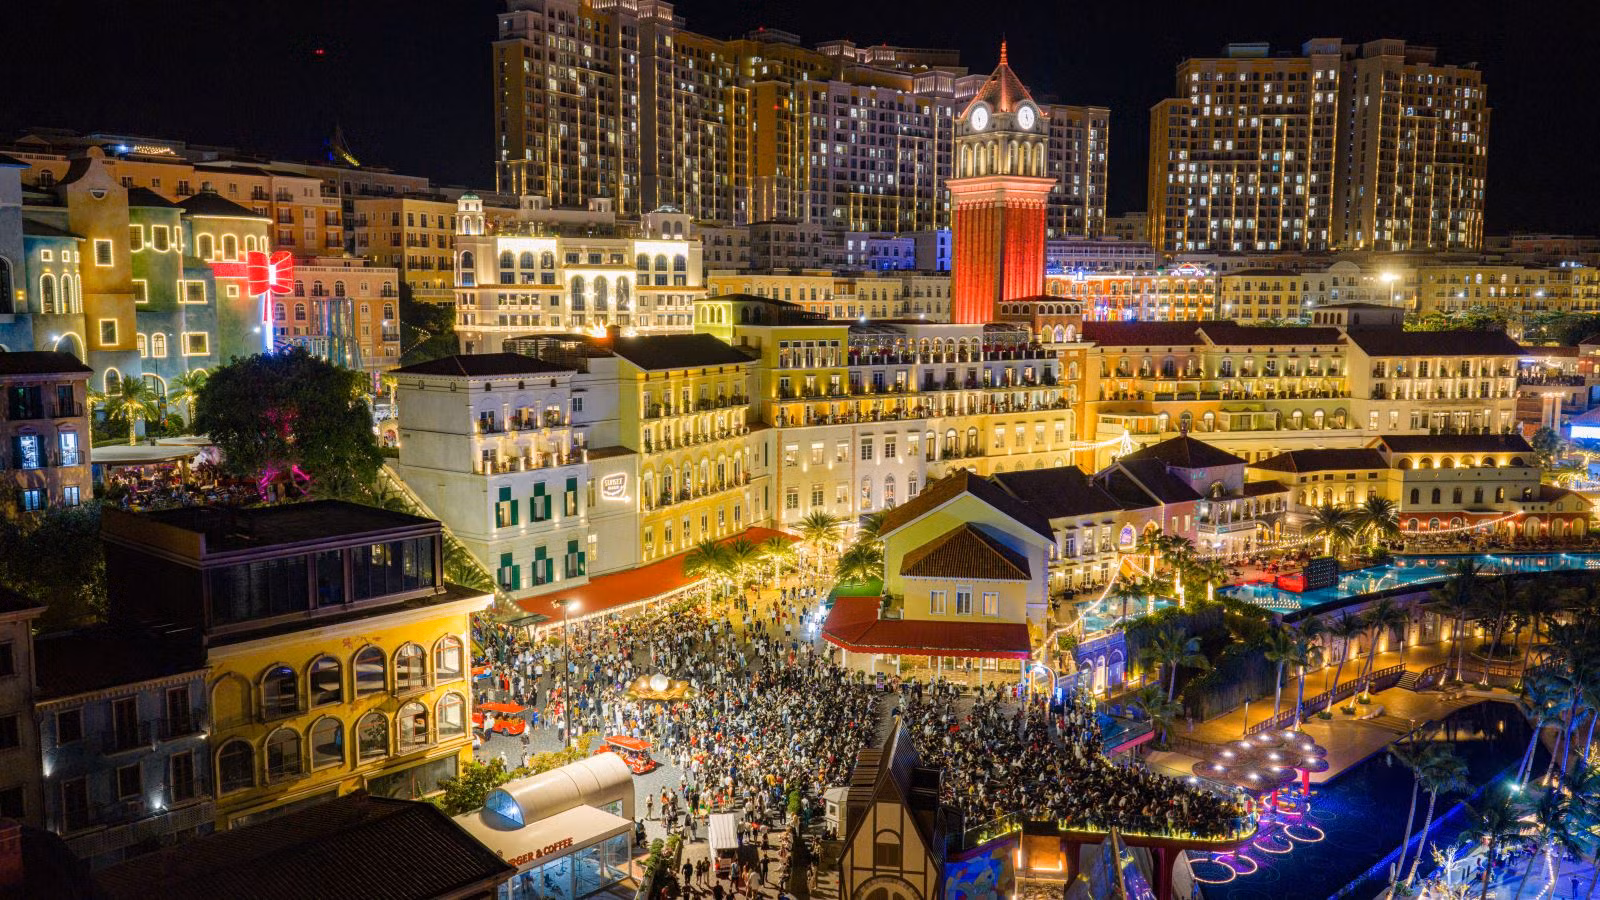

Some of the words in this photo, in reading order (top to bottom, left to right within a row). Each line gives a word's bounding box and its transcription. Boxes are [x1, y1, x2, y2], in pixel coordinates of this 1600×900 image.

[508, 852, 534, 866] RGER
[536, 848, 543, 858] &
[543, 837, 573, 855] COFFEE
